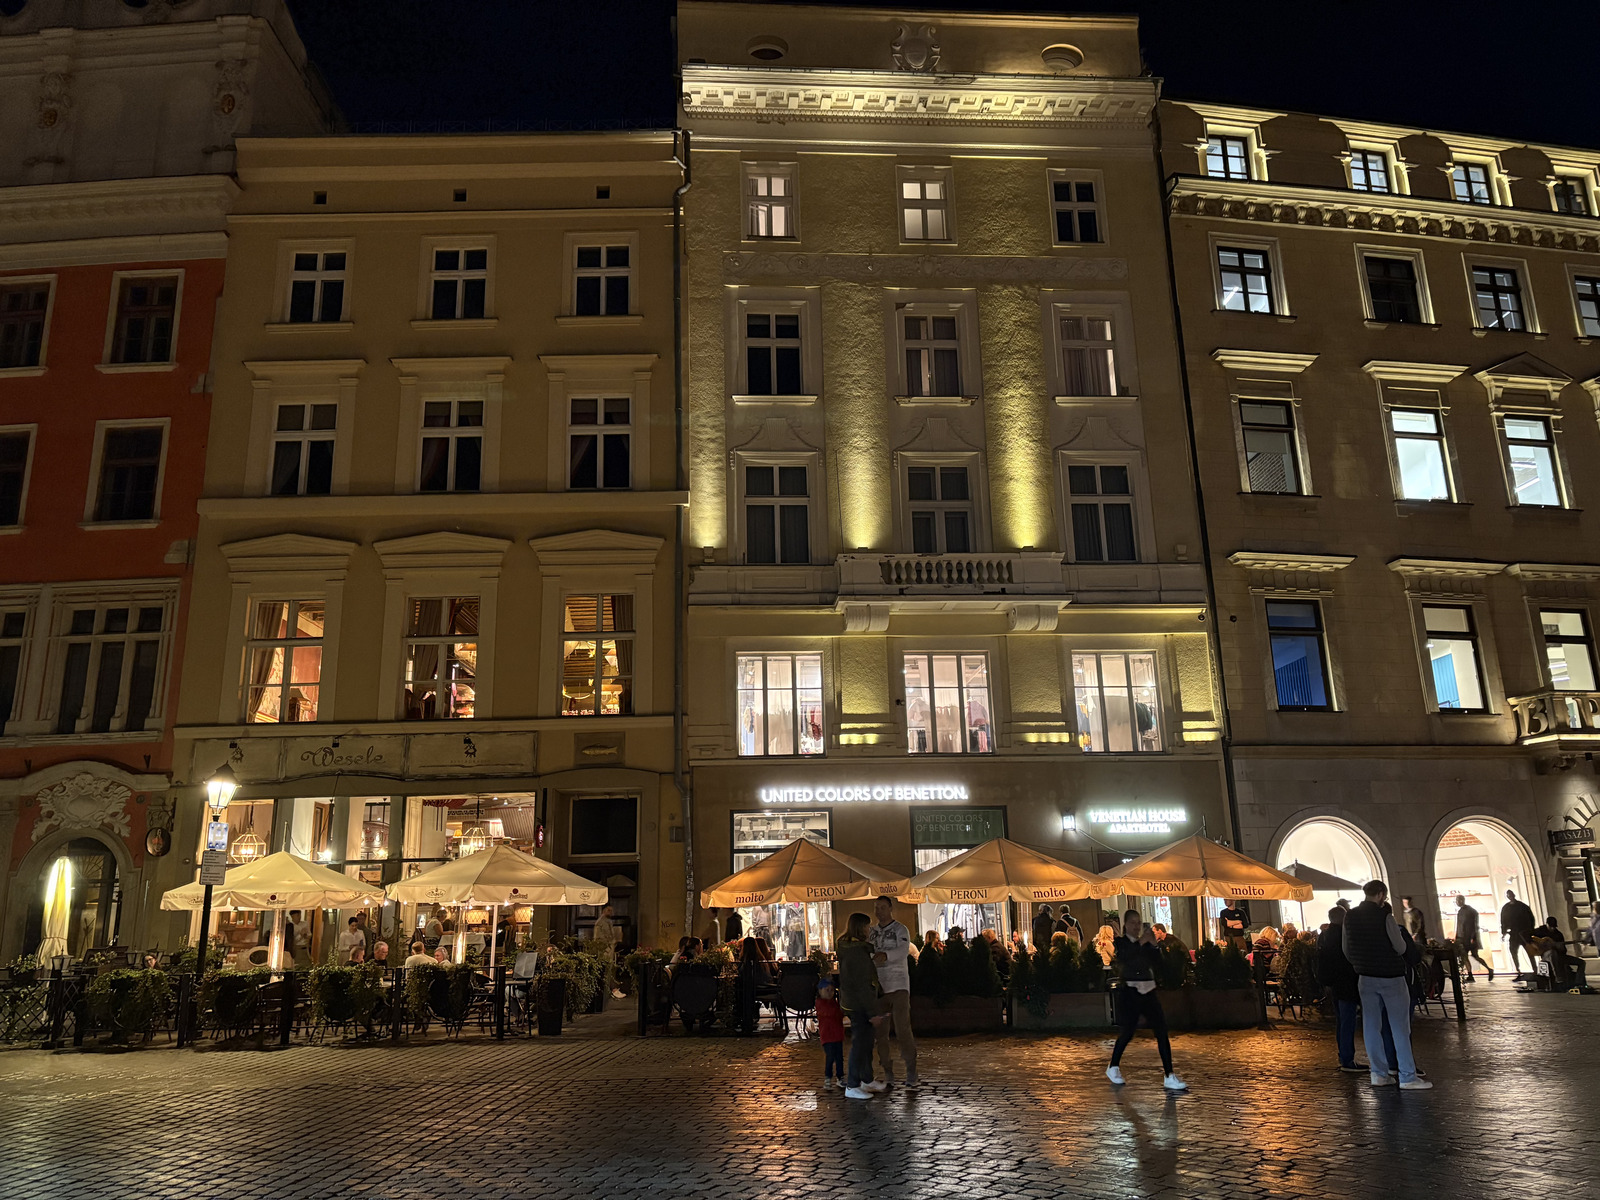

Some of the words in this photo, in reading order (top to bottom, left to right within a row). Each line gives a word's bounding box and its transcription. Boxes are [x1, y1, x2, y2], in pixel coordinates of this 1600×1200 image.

[300, 745, 386, 767] Wesele
[761, 788, 814, 803] UNITED
[815, 787, 871, 802] COLORS
[873, 787, 893, 801] OF
[915, 814, 947, 823] UNITED
[948, 814, 983, 823] COLORS
[1148, 808, 1187, 822] HOUSE
[915, 823, 928, 832] OF
[806, 885, 846, 898] PERONI
[879, 883, 898, 894] molto
[1146, 881, 1185, 892] PERONI
[1231, 885, 1265, 896] molto
[735, 892, 764, 904] molto
[950, 889, 988, 900] PERONI
[1033, 887, 1066, 898] molto
